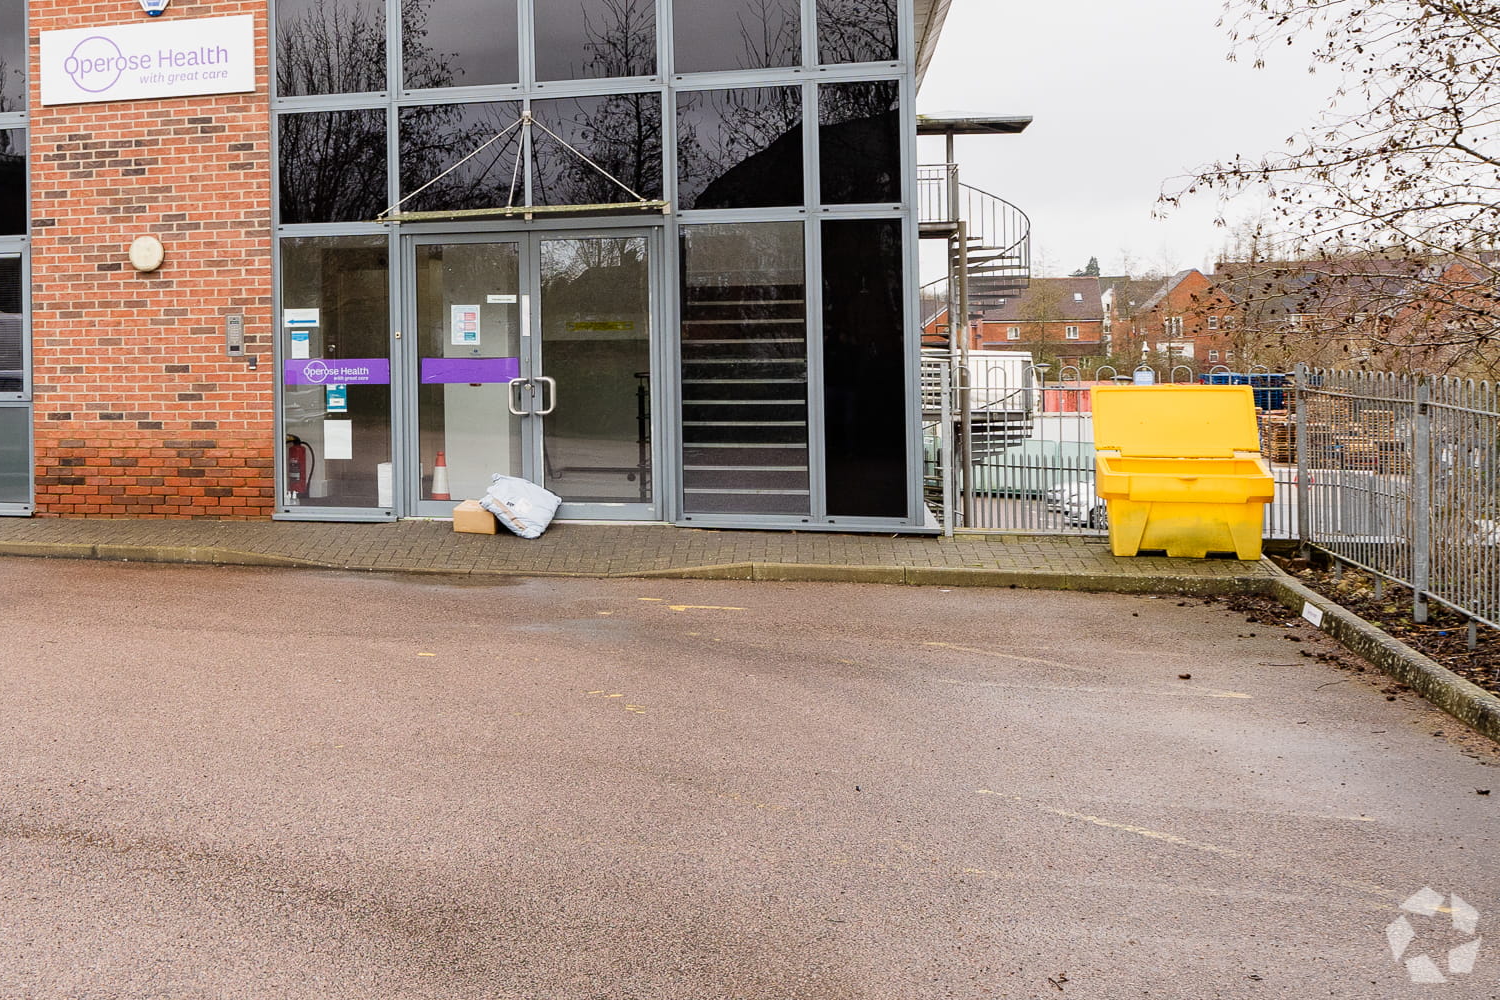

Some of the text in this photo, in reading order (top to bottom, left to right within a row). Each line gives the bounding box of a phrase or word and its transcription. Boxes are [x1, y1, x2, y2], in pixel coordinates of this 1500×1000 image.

[64, 45, 229, 80] Operose Health
[139, 69, 229, 85] with great care
[303, 367, 369, 378] Operose Health
